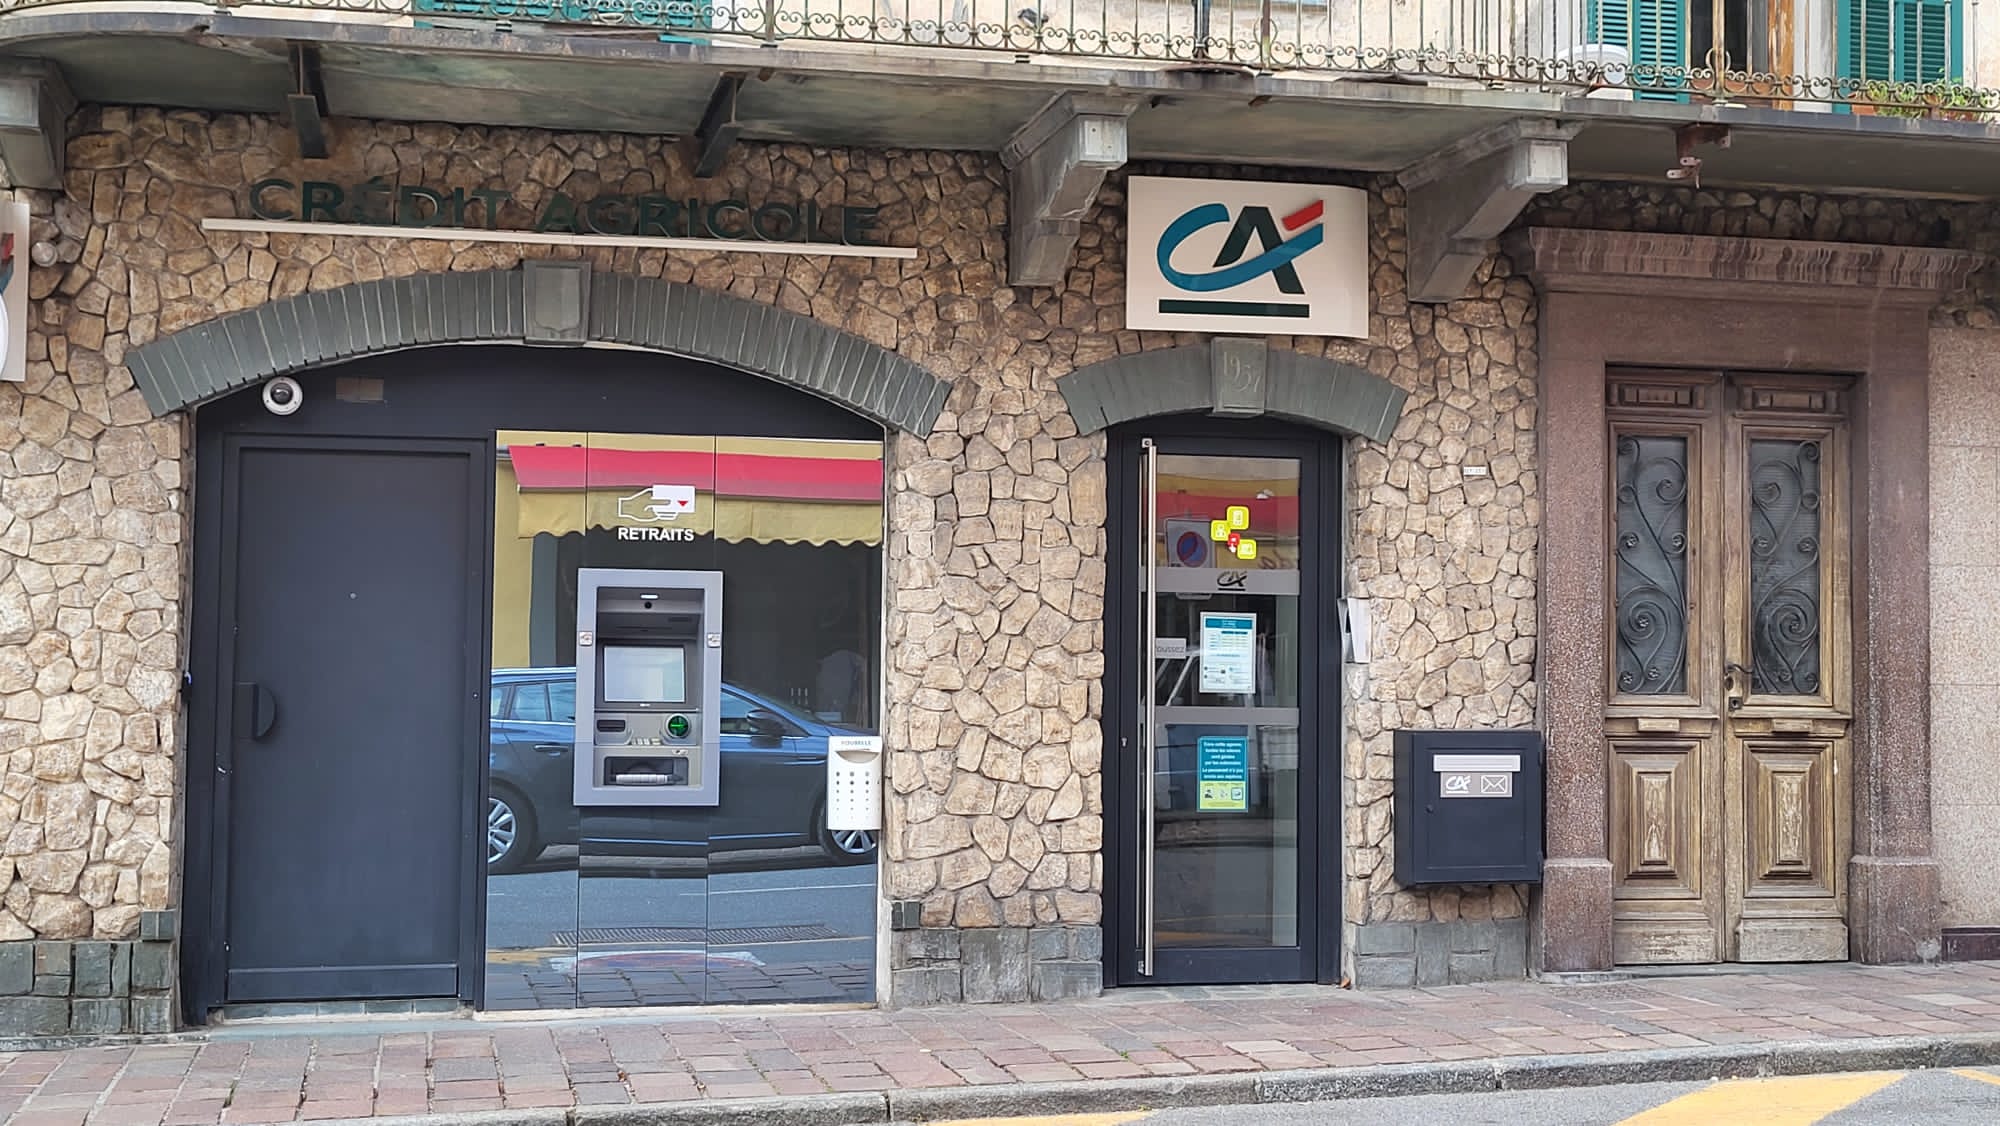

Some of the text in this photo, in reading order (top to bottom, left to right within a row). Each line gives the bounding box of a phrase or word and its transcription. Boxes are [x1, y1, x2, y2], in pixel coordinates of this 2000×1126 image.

[250, 176, 881, 246] CRÉDIT AGRICOLE
[618, 527, 694, 541] RETRAITS
